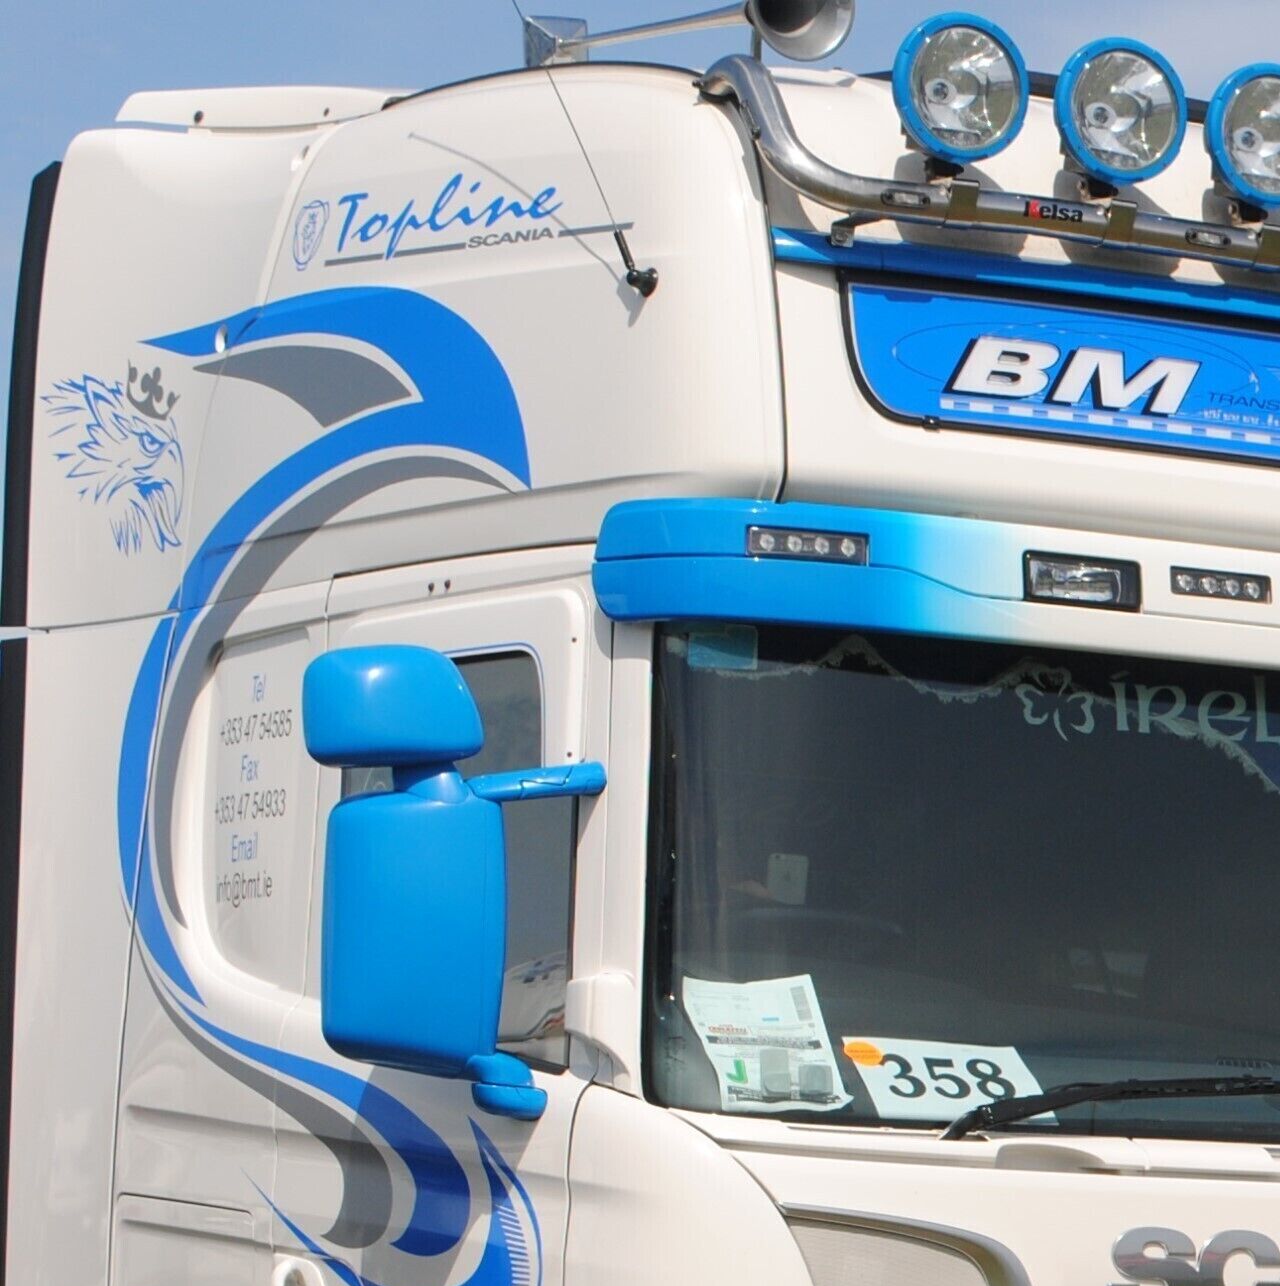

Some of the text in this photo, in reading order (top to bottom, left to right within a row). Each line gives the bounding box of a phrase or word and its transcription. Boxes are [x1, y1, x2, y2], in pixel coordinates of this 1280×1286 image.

[337, 174, 563, 260] Topline
[1024, 200, 1083, 222] Kelsa
[466, 227, 555, 249] SCANIA
[944, 336, 1201, 417] BM
[252, 674, 266, 701] Tel
[220, 709, 292, 745] +353 47 54585
[240, 755, 259, 782] Fax
[215, 789, 286, 824] +353 47 54933
[231, 832, 258, 863] Email
[216, 871, 272, 908] info@bmt.ie
[880, 1054, 1016, 1100] 358
